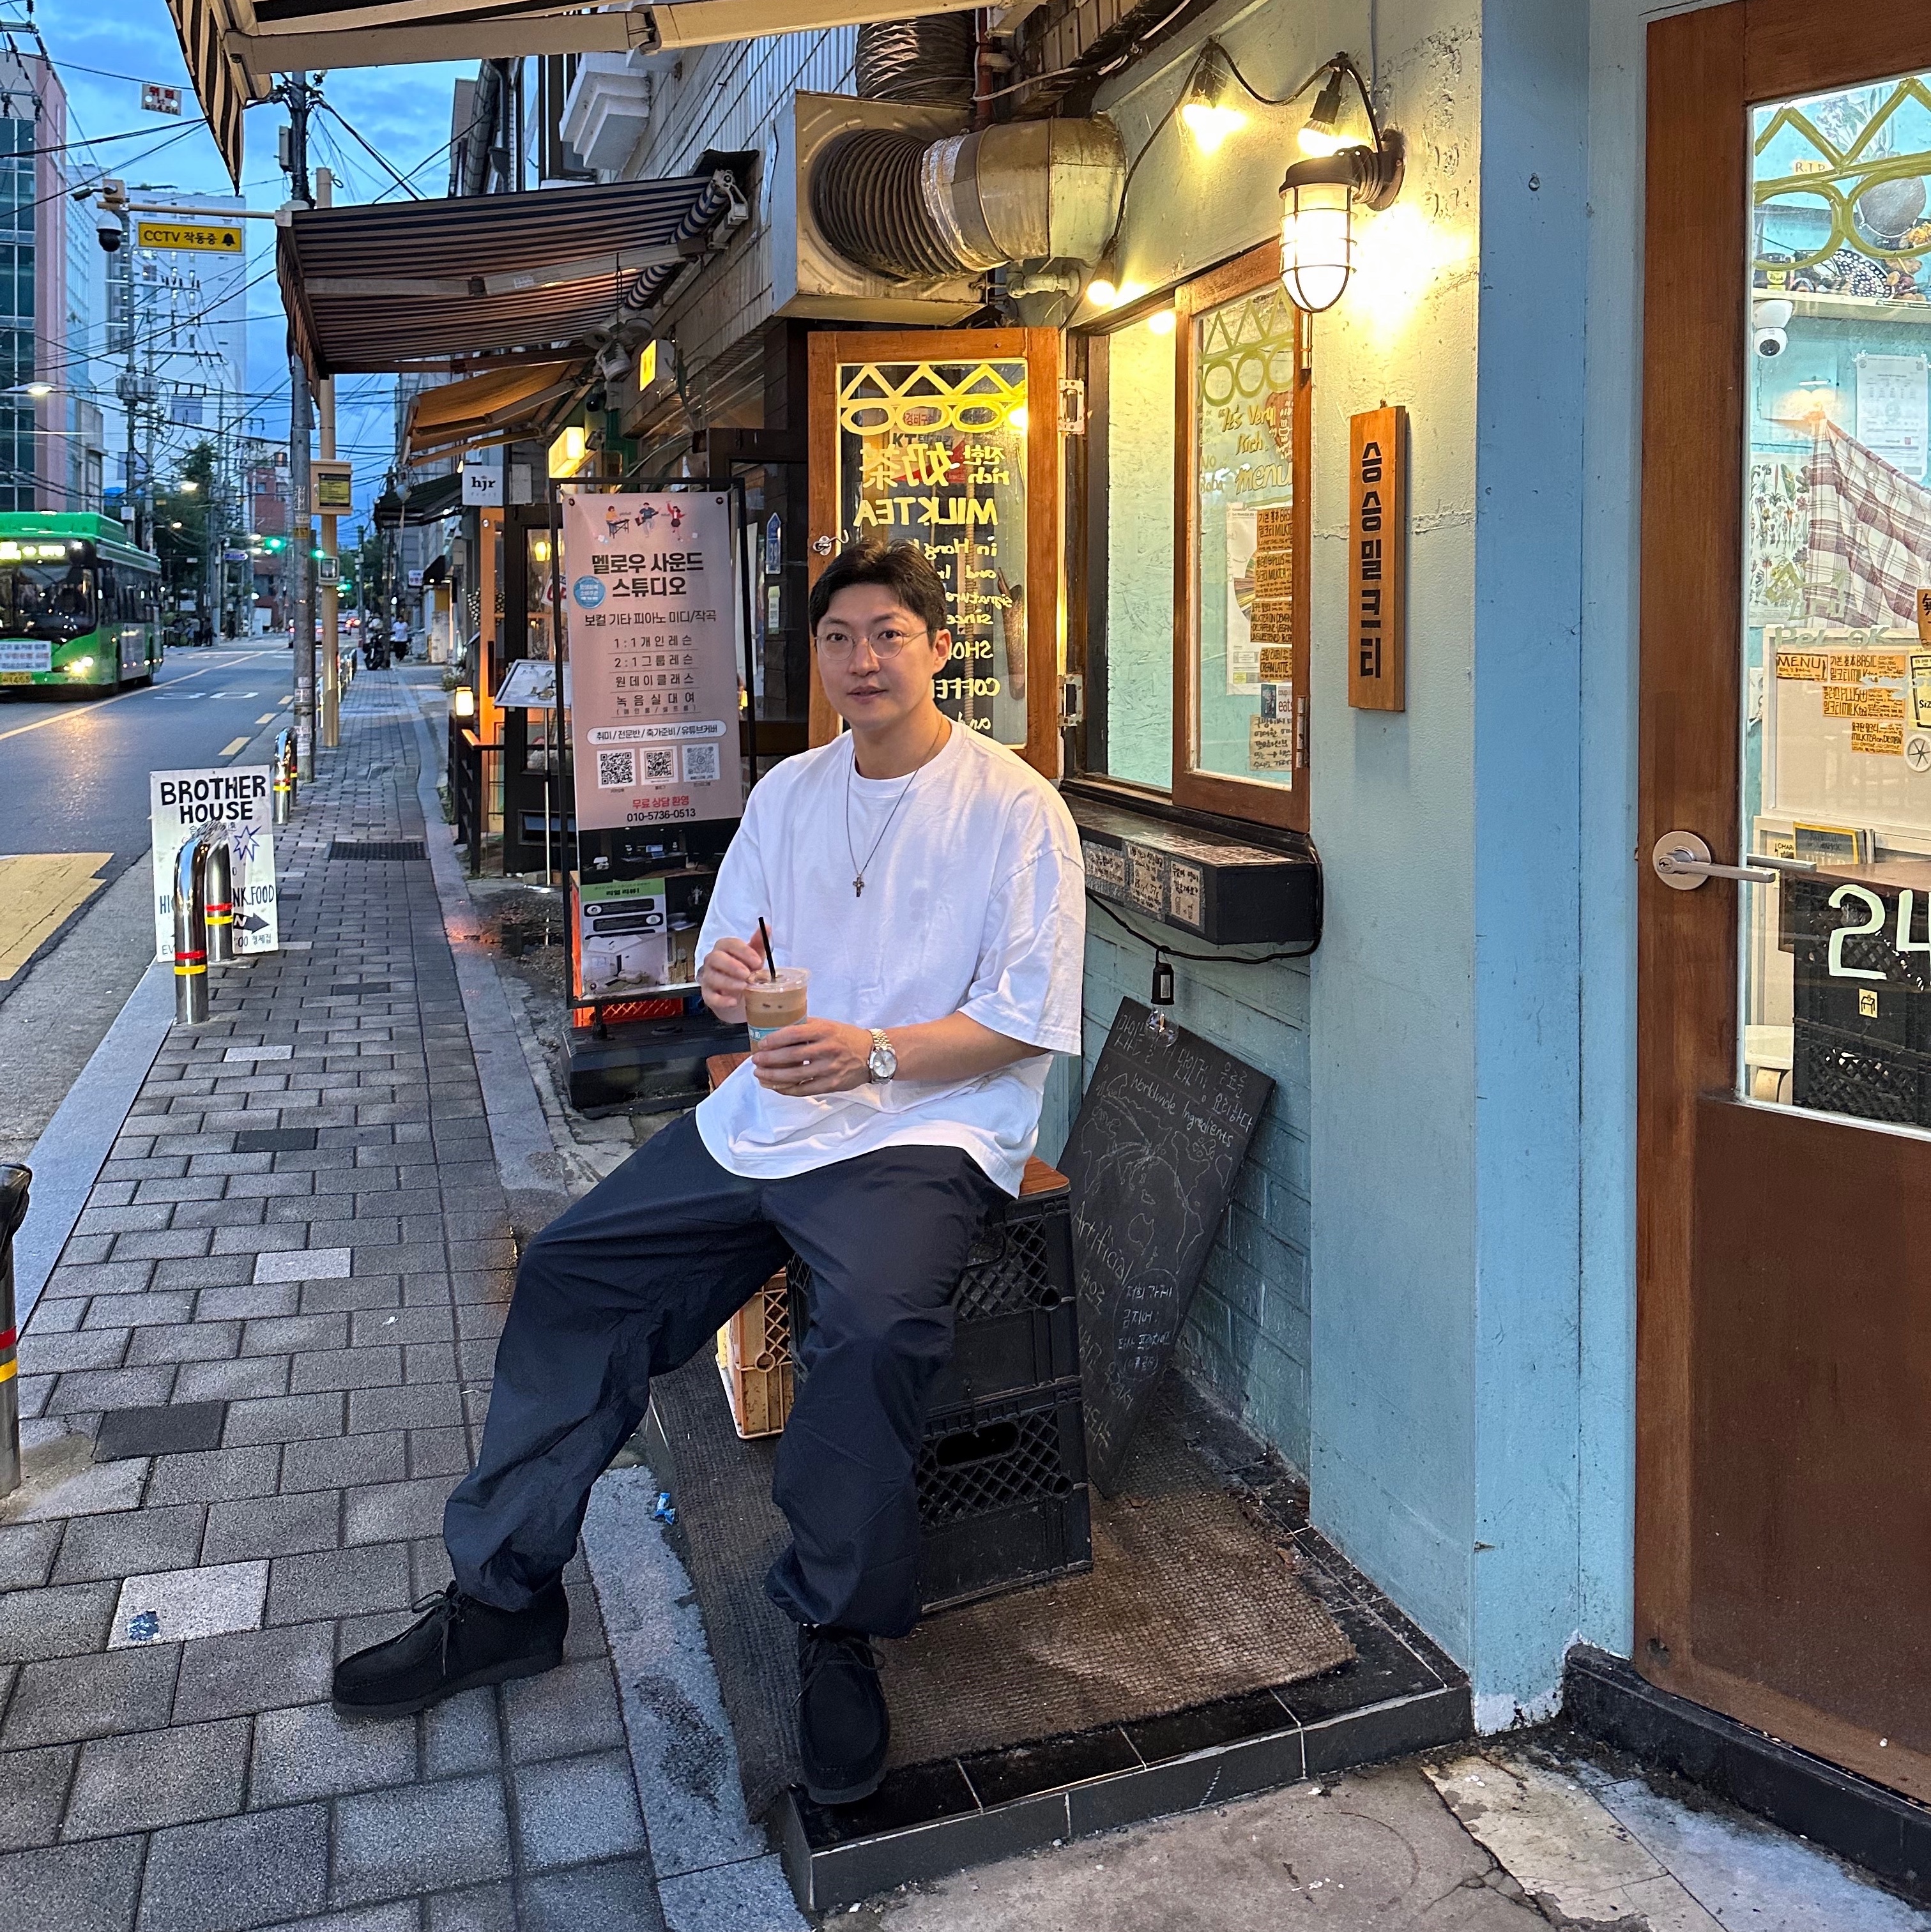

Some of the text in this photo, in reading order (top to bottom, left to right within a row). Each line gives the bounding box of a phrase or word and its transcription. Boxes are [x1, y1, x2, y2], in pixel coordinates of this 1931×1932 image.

[144, 230, 217, 245] CCTV 작동중
[1249, 405, 1276, 426] Very
[471, 475, 496, 491] hjr
[1236, 462, 1292, 495] menu
[592, 552, 705, 575] 멜로우 사운드
[1361, 441, 1383, 679] 슴슴밀크티
[612, 576, 687, 598] 스튜디오
[584, 609, 717, 627] 보컬 기타 피아노 미디/작곡
[1847, 626, 1890, 650] OK
[1778, 655, 1821, 669] MENU
[1831, 668, 1850, 682] 밀크티
[682, 725, 718, 736] 유튜브커버
[161, 775, 266, 806] BROTHER
[180, 801, 253, 824] HOUSE
[632, 795, 689, 809] 무료 상담 환영
[627, 808, 696, 822] 010-5736-0513
[233, 887, 250, 907] NK
[251, 885, 275, 906] FOOD
[162, 944, 174, 955] EV
[1130, 1072, 1234, 1148] Worldwide Ingredients
[1212, 1092, 1253, 1134] 요리하다
[1071, 1199, 1133, 1286] Artificial
